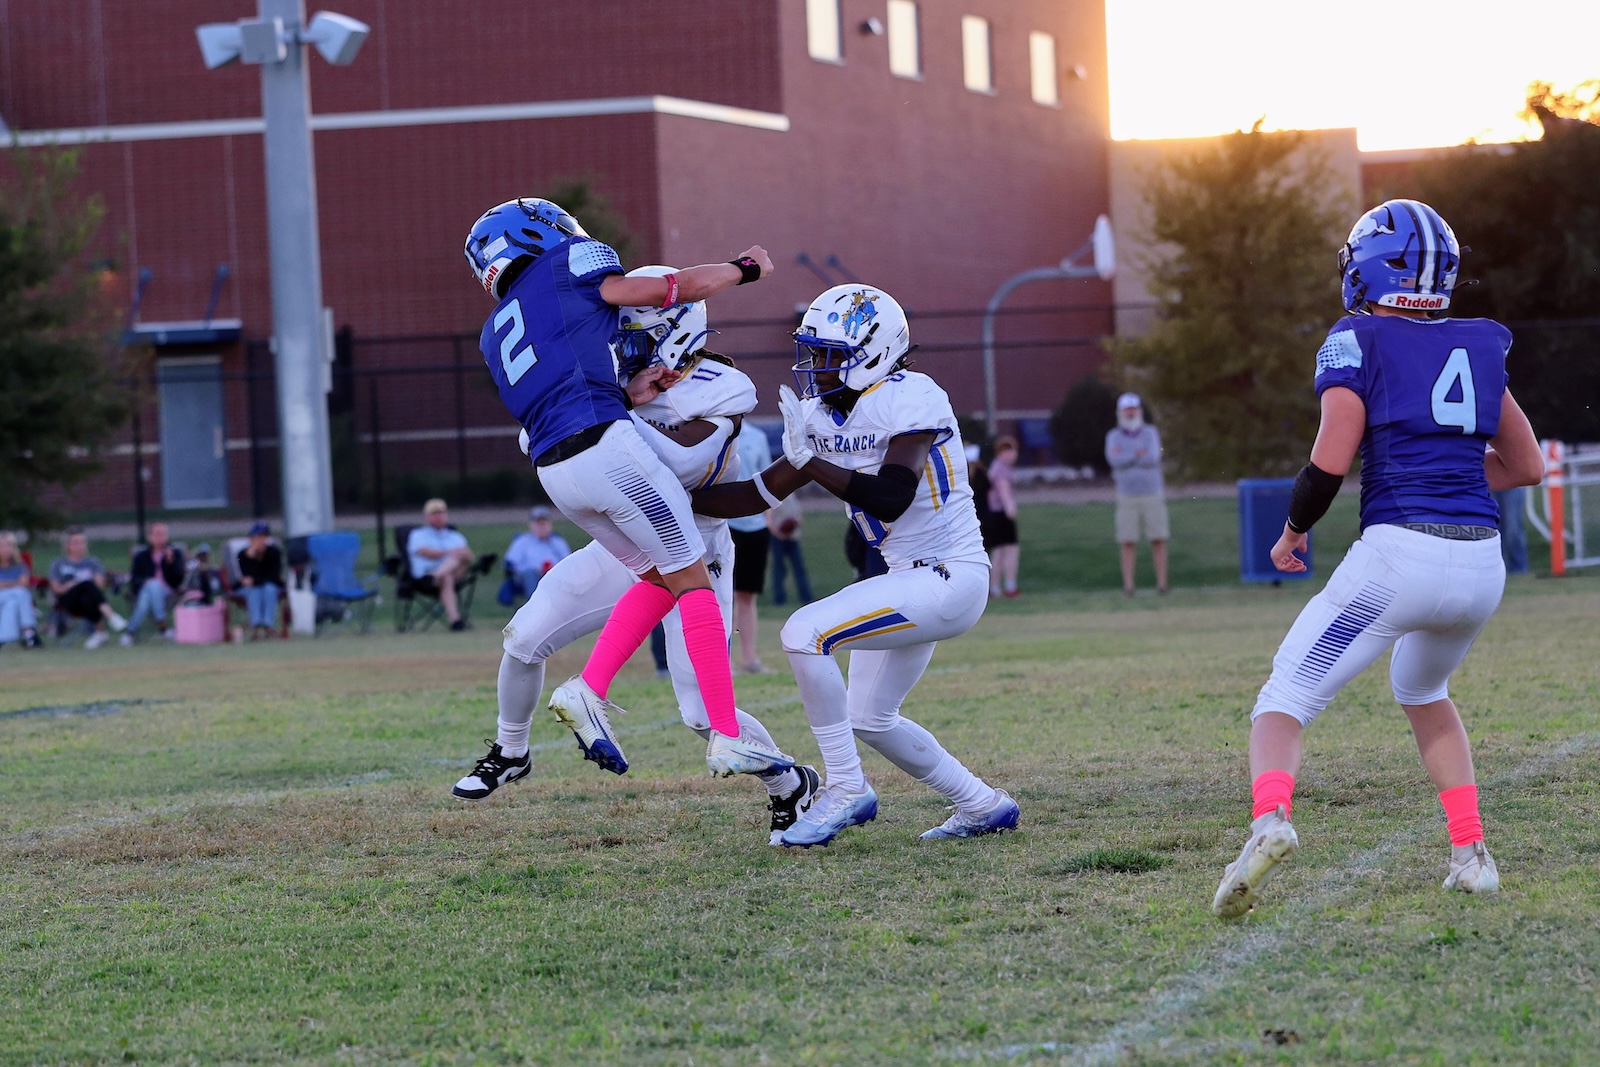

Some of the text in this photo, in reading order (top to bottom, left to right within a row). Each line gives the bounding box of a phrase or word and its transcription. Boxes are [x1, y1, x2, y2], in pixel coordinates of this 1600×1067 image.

[484, 265, 499, 294] ddell
[1395, 296, 1443, 308] Riddell
[493, 296, 539, 387] 2
[691, 367, 723, 381] 11
[1431, 347, 1477, 435] 4
[834, 433, 876, 453] RANCH
